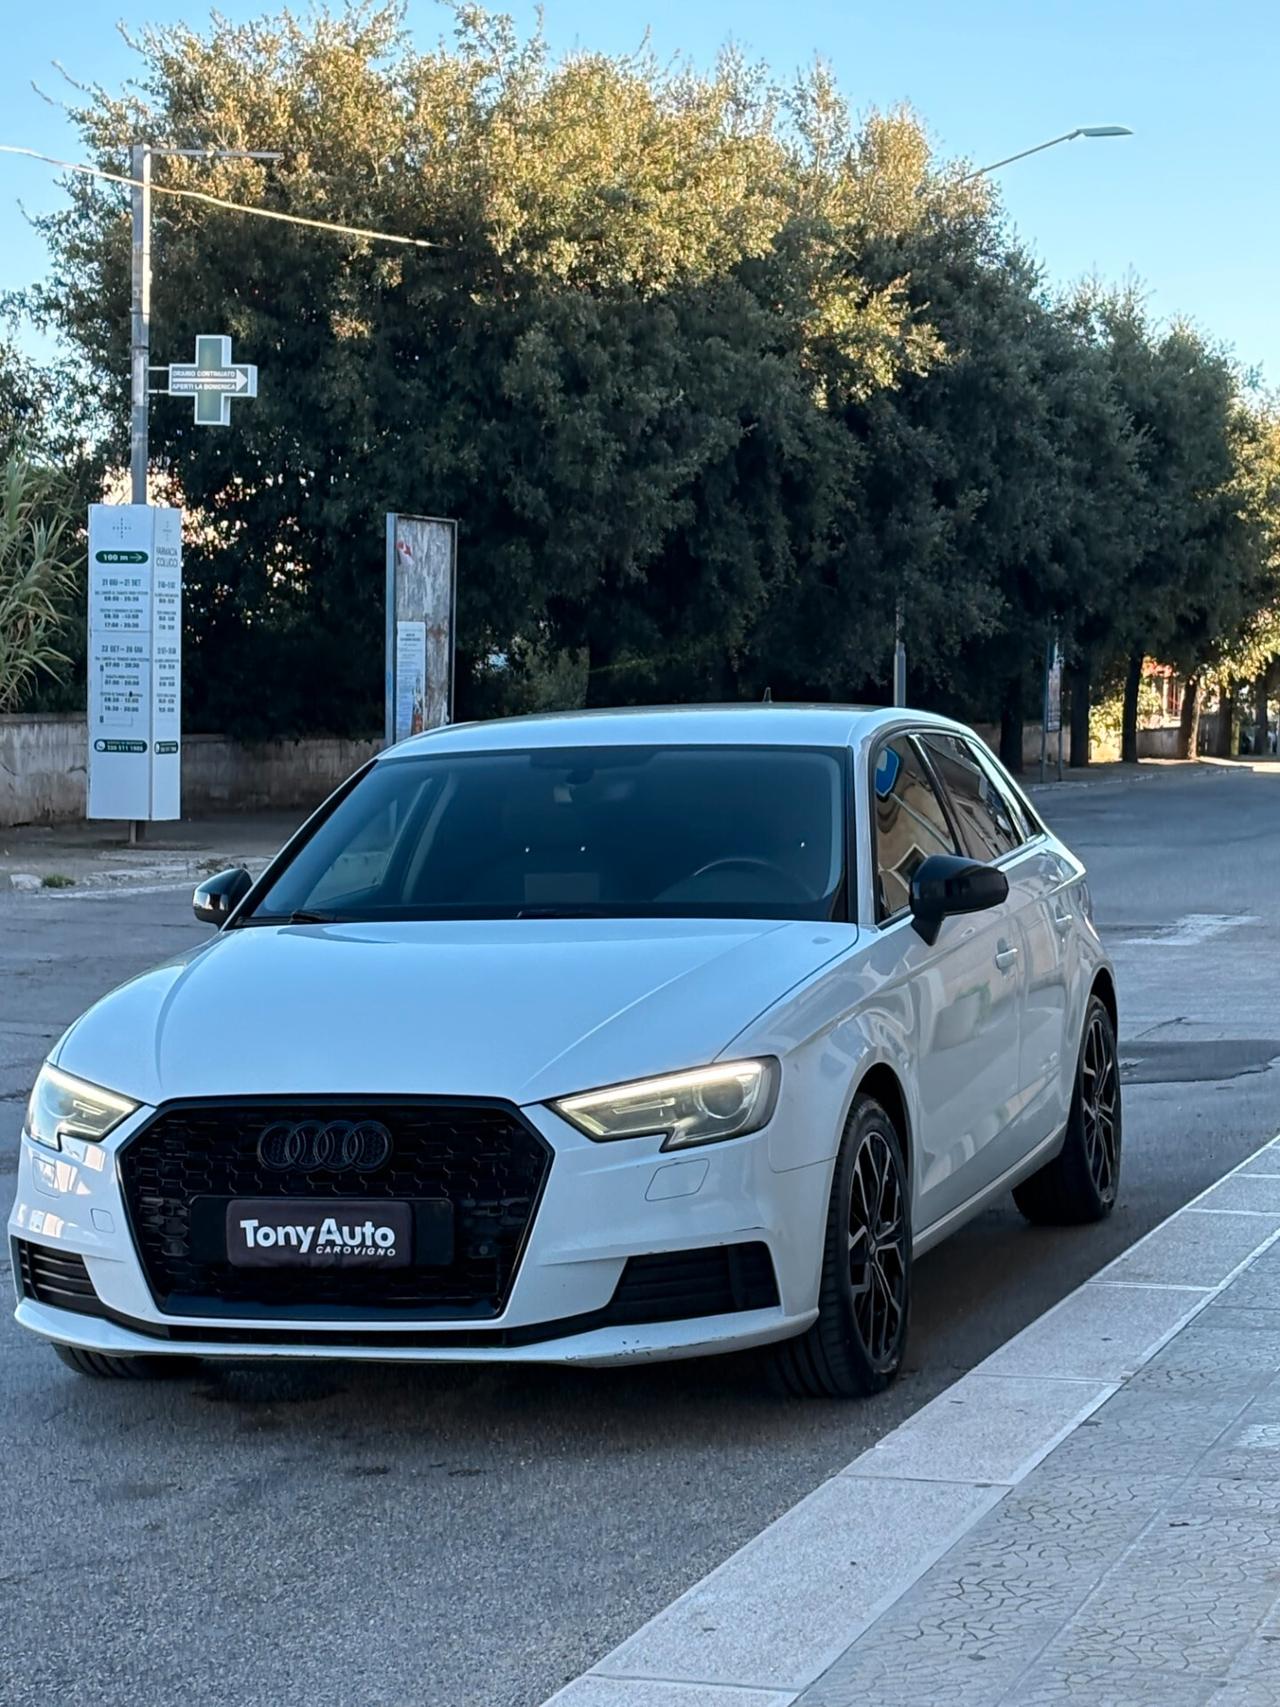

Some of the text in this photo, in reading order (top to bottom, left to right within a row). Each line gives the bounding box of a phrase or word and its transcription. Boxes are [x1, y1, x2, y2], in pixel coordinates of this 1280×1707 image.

[103, 553, 118, 561] 100
[240, 1218, 396, 1253] Tony Auto
[316, 1246, 396, 1256] CAROVIGNO
